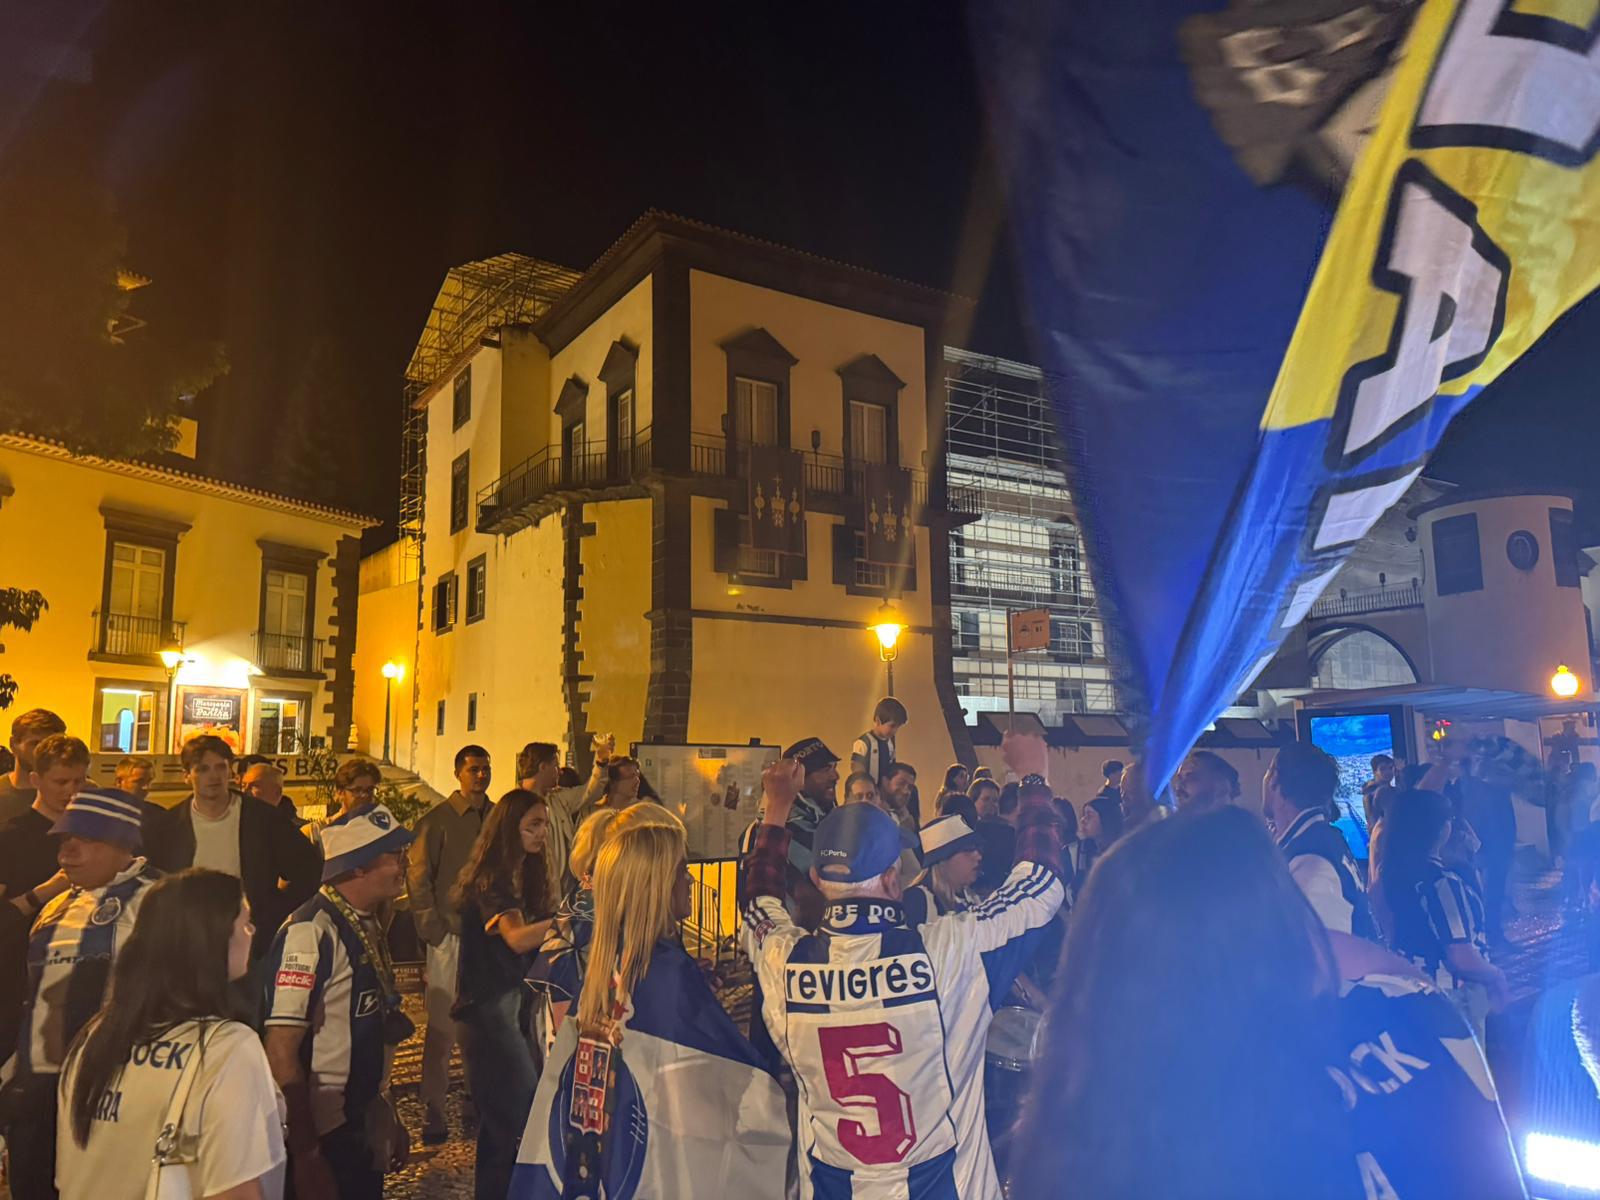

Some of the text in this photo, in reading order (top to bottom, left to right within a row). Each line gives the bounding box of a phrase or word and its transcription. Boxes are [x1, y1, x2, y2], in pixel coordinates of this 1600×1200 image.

[296, 759, 338, 776] BAR
[278, 974, 312, 986] Betclic
[131, 1040, 193, 1069] OCK
[818, 1022, 917, 1165] 5
